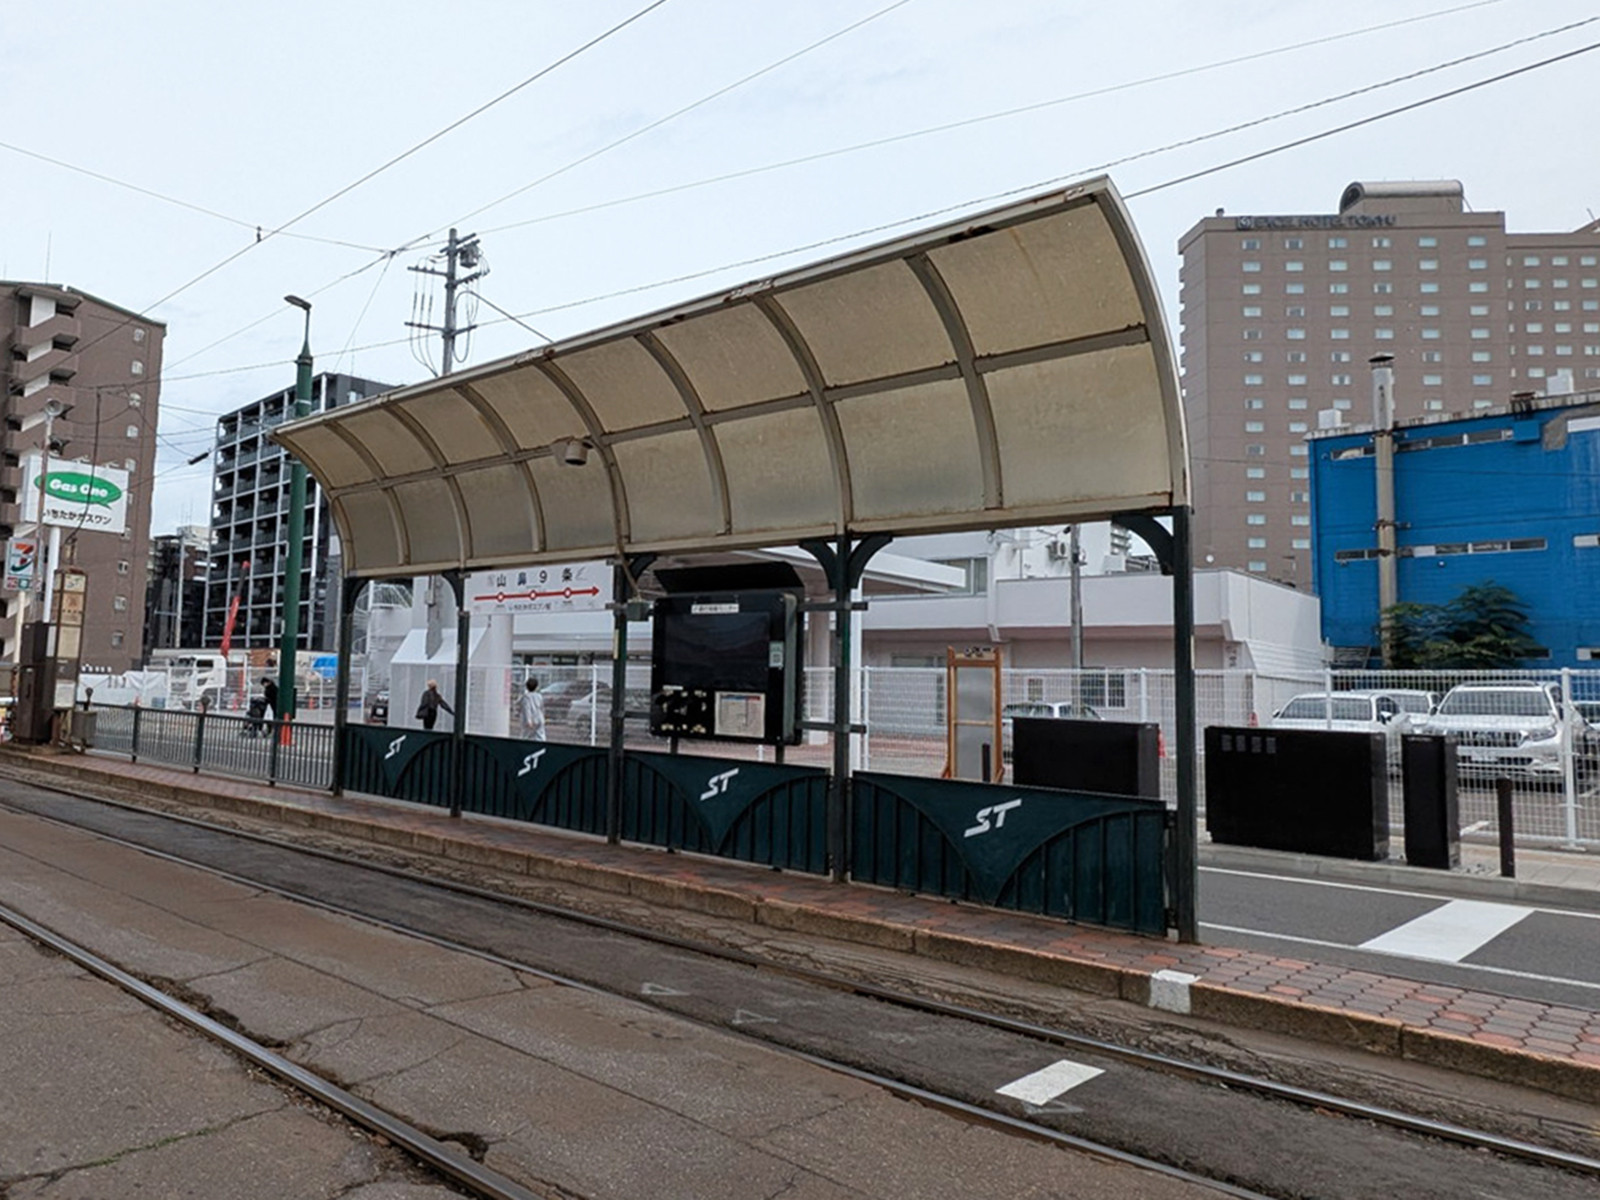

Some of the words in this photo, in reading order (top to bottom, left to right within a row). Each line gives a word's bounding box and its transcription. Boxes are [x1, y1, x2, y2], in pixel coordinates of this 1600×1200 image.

[49, 478, 78, 494] Gas
[79, 483, 109, 498] One
[384, 735, 406, 760] ST
[517, 748, 546, 777] ST
[700, 768, 740, 801] ST
[963, 798, 1022, 838] ST
